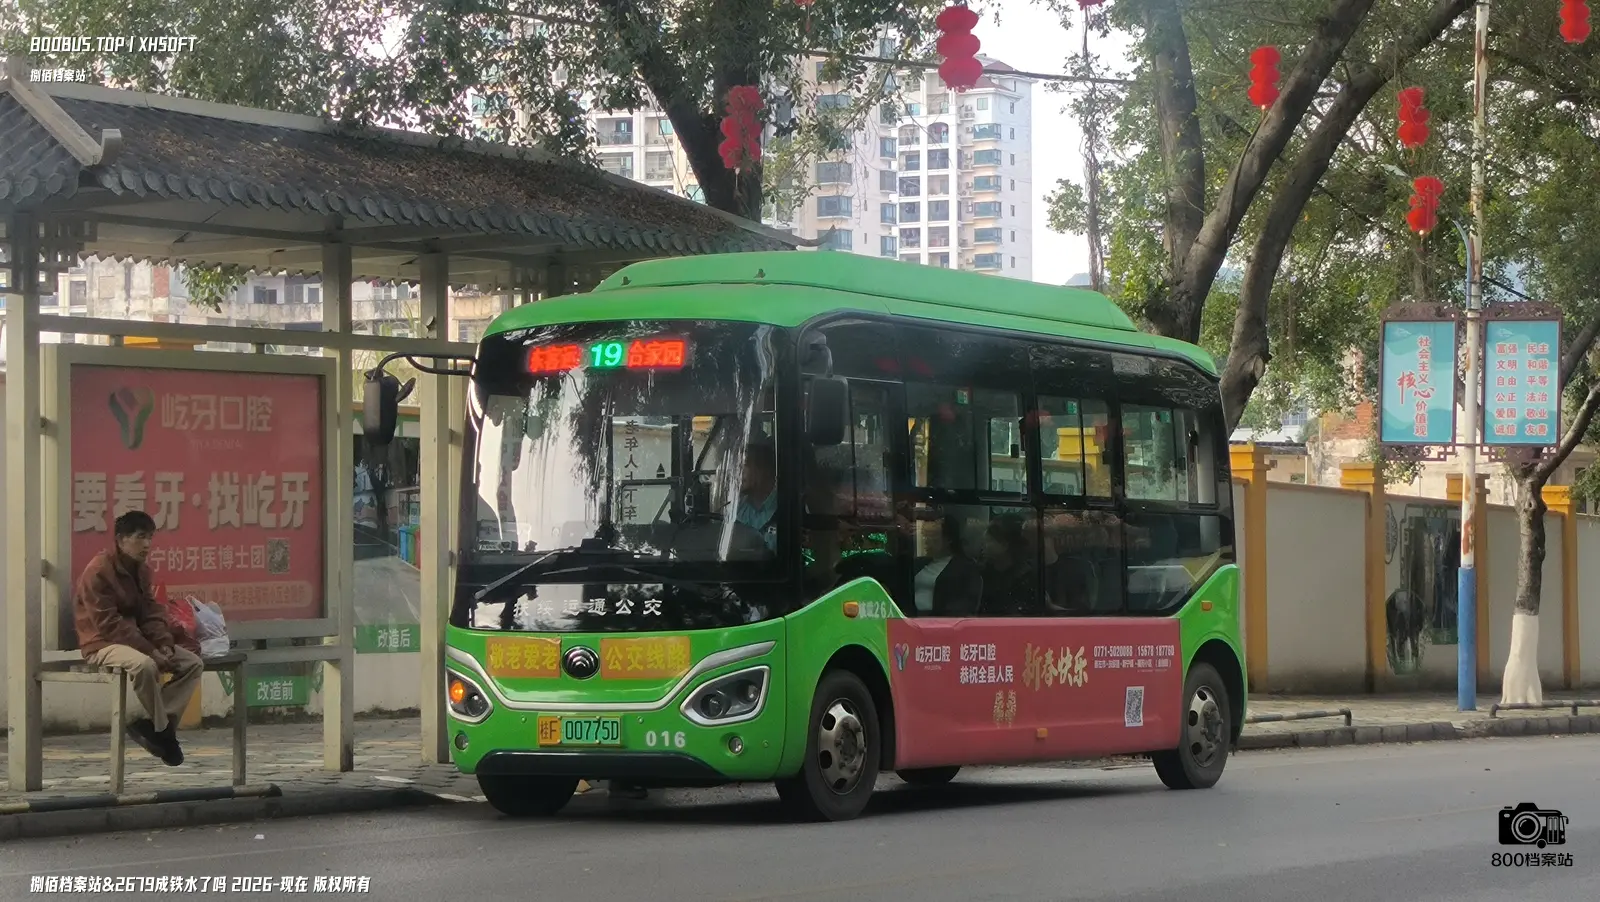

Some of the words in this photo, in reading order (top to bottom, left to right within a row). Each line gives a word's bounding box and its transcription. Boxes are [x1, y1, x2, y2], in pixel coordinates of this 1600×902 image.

[591, 342, 623, 367] 19
[1496, 343, 1517, 354] 富强
[1527, 343, 1548, 354] 民主
[1496, 360, 1517, 370] 文明
[1527, 360, 1548, 370] 和谐
[1496, 376, 1517, 387] 自由
[1527, 376, 1548, 386] 平等
[1495, 392, 1517, 402] 公正
[1526, 392, 1548, 402] 法治
[161, 392, 273, 432] 屹牙口腔
[1495, 408, 1517, 419] 爱国
[1526, 408, 1548, 419] 敬业
[1495, 424, 1517, 435] 诚信
[1526, 424, 1548, 435] 友善
[73, 470, 310, 533] 要看牙·找屹牙
[150, 545, 266, 574] 宁的牙医博士团
[513, 598, 663, 617] 扶绥运通公交
[377, 628, 411, 648] 改造后
[490, 643, 559, 671] 敬老爱老
[605, 645, 688, 672] 公交线路
[915, 645, 951, 663] 屹牙口腔
[959, 643, 997, 661] 屹牙口腔
[959, 665, 1014, 684] 恭祝全县人民
[1022, 643, 1089, 692] 新春快乐
[257, 681, 294, 701] 改造前
[540, 720, 558, 740] 桂F
[565, 720, 619, 740] 00775D
[646, 730, 686, 748] 016
